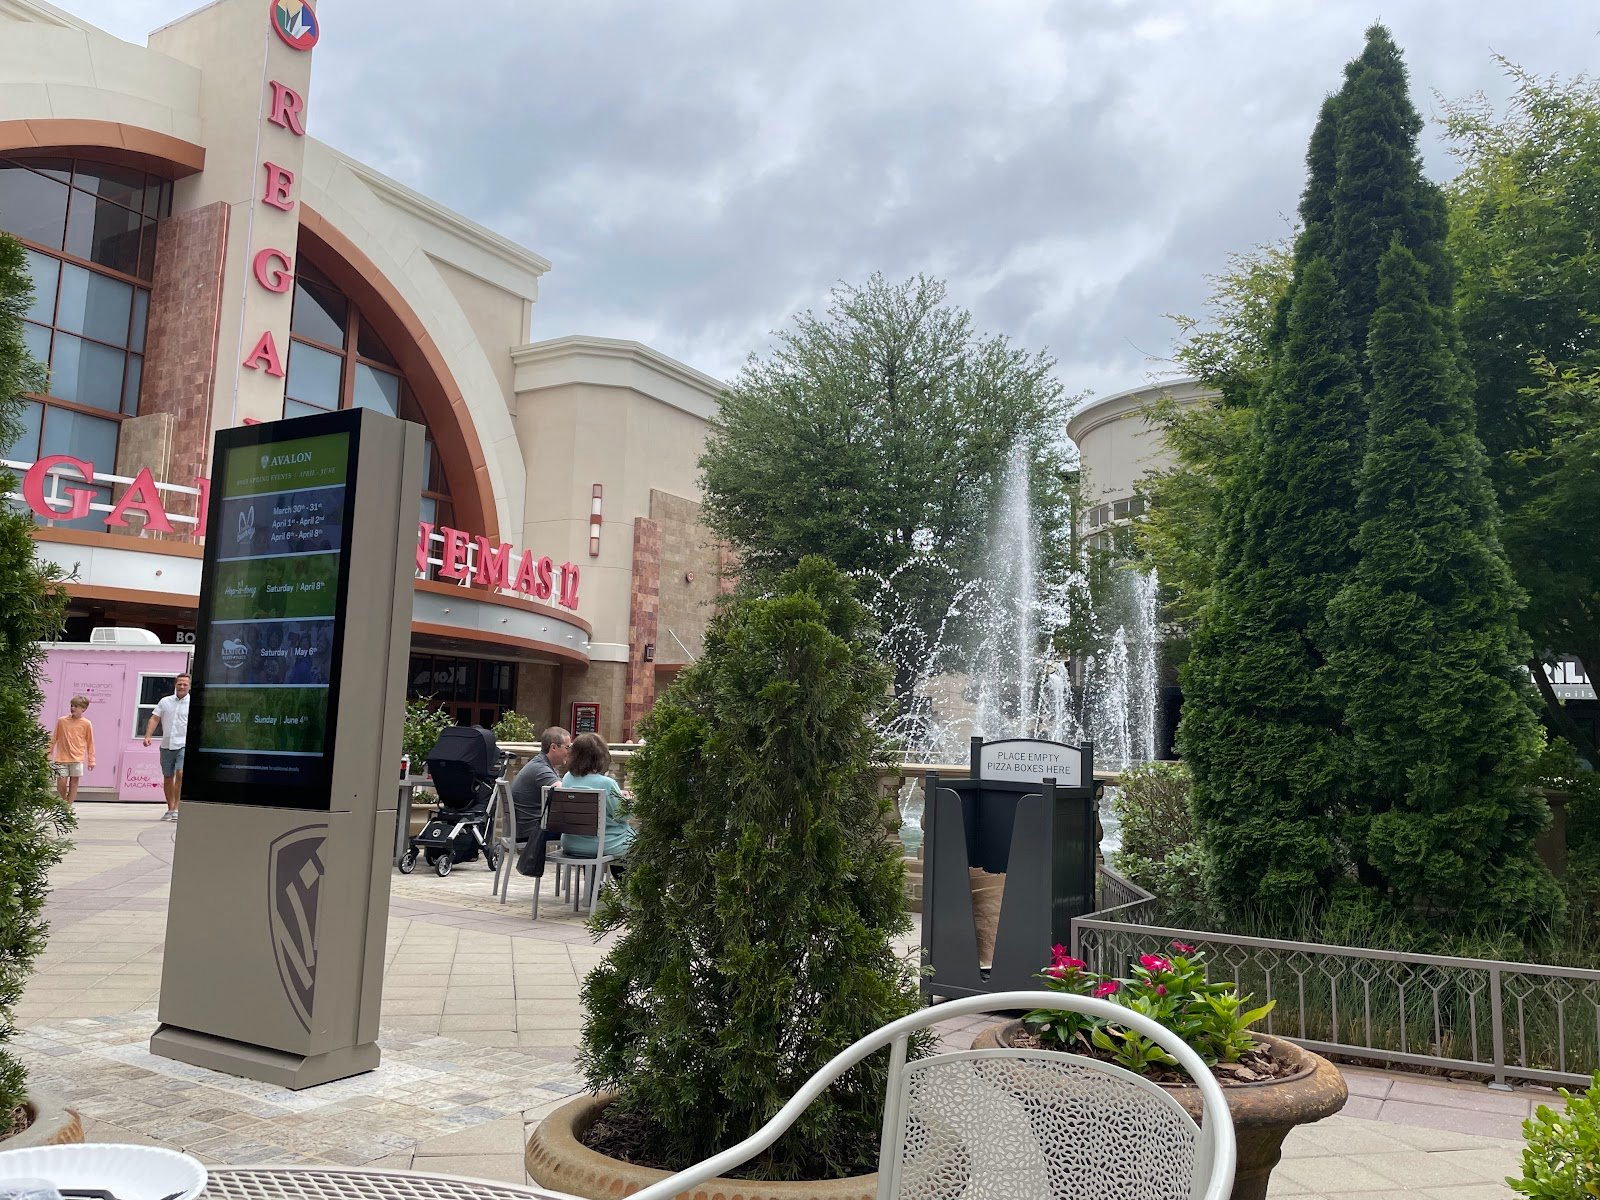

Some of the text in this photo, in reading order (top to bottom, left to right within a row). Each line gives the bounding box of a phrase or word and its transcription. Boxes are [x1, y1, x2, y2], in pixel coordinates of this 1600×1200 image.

[242, 80, 305, 425] REGA
[271, 452, 313, 466] AVALON
[273, 505, 292, 515] March
[292, 503, 306, 513] 30th
[309, 502, 323, 511] 31st
[272, 518, 287, 529] April
[287, 518, 296, 527] 1st
[299, 516, 314, 526] April
[314, 515, 325, 524] 2nd
[271, 532, 286, 542] April
[286, 531, 295, 540] 6th
[298, 530, 314, 540] April
[314, 529, 324, 538] 8th
[266, 584, 294, 593] Saturday
[299, 581, 316, 592] April
[316, 581, 325, 590] 8th
[558, 561, 581, 611] 12
[260, 648, 289, 657] Saturday
[294, 648, 309, 657] May
[309, 647, 318, 656] 6th
[215, 712, 241, 723] SAVOR
[254, 715, 278, 725] Sunday
[283, 715, 299, 724] June
[299, 716, 309, 724] 4th
[997, 751, 1060, 763] PLACE EMPTY
[126, 767, 150, 782] love
[987, 762, 1071, 775] PIZZA BOXES HERE
